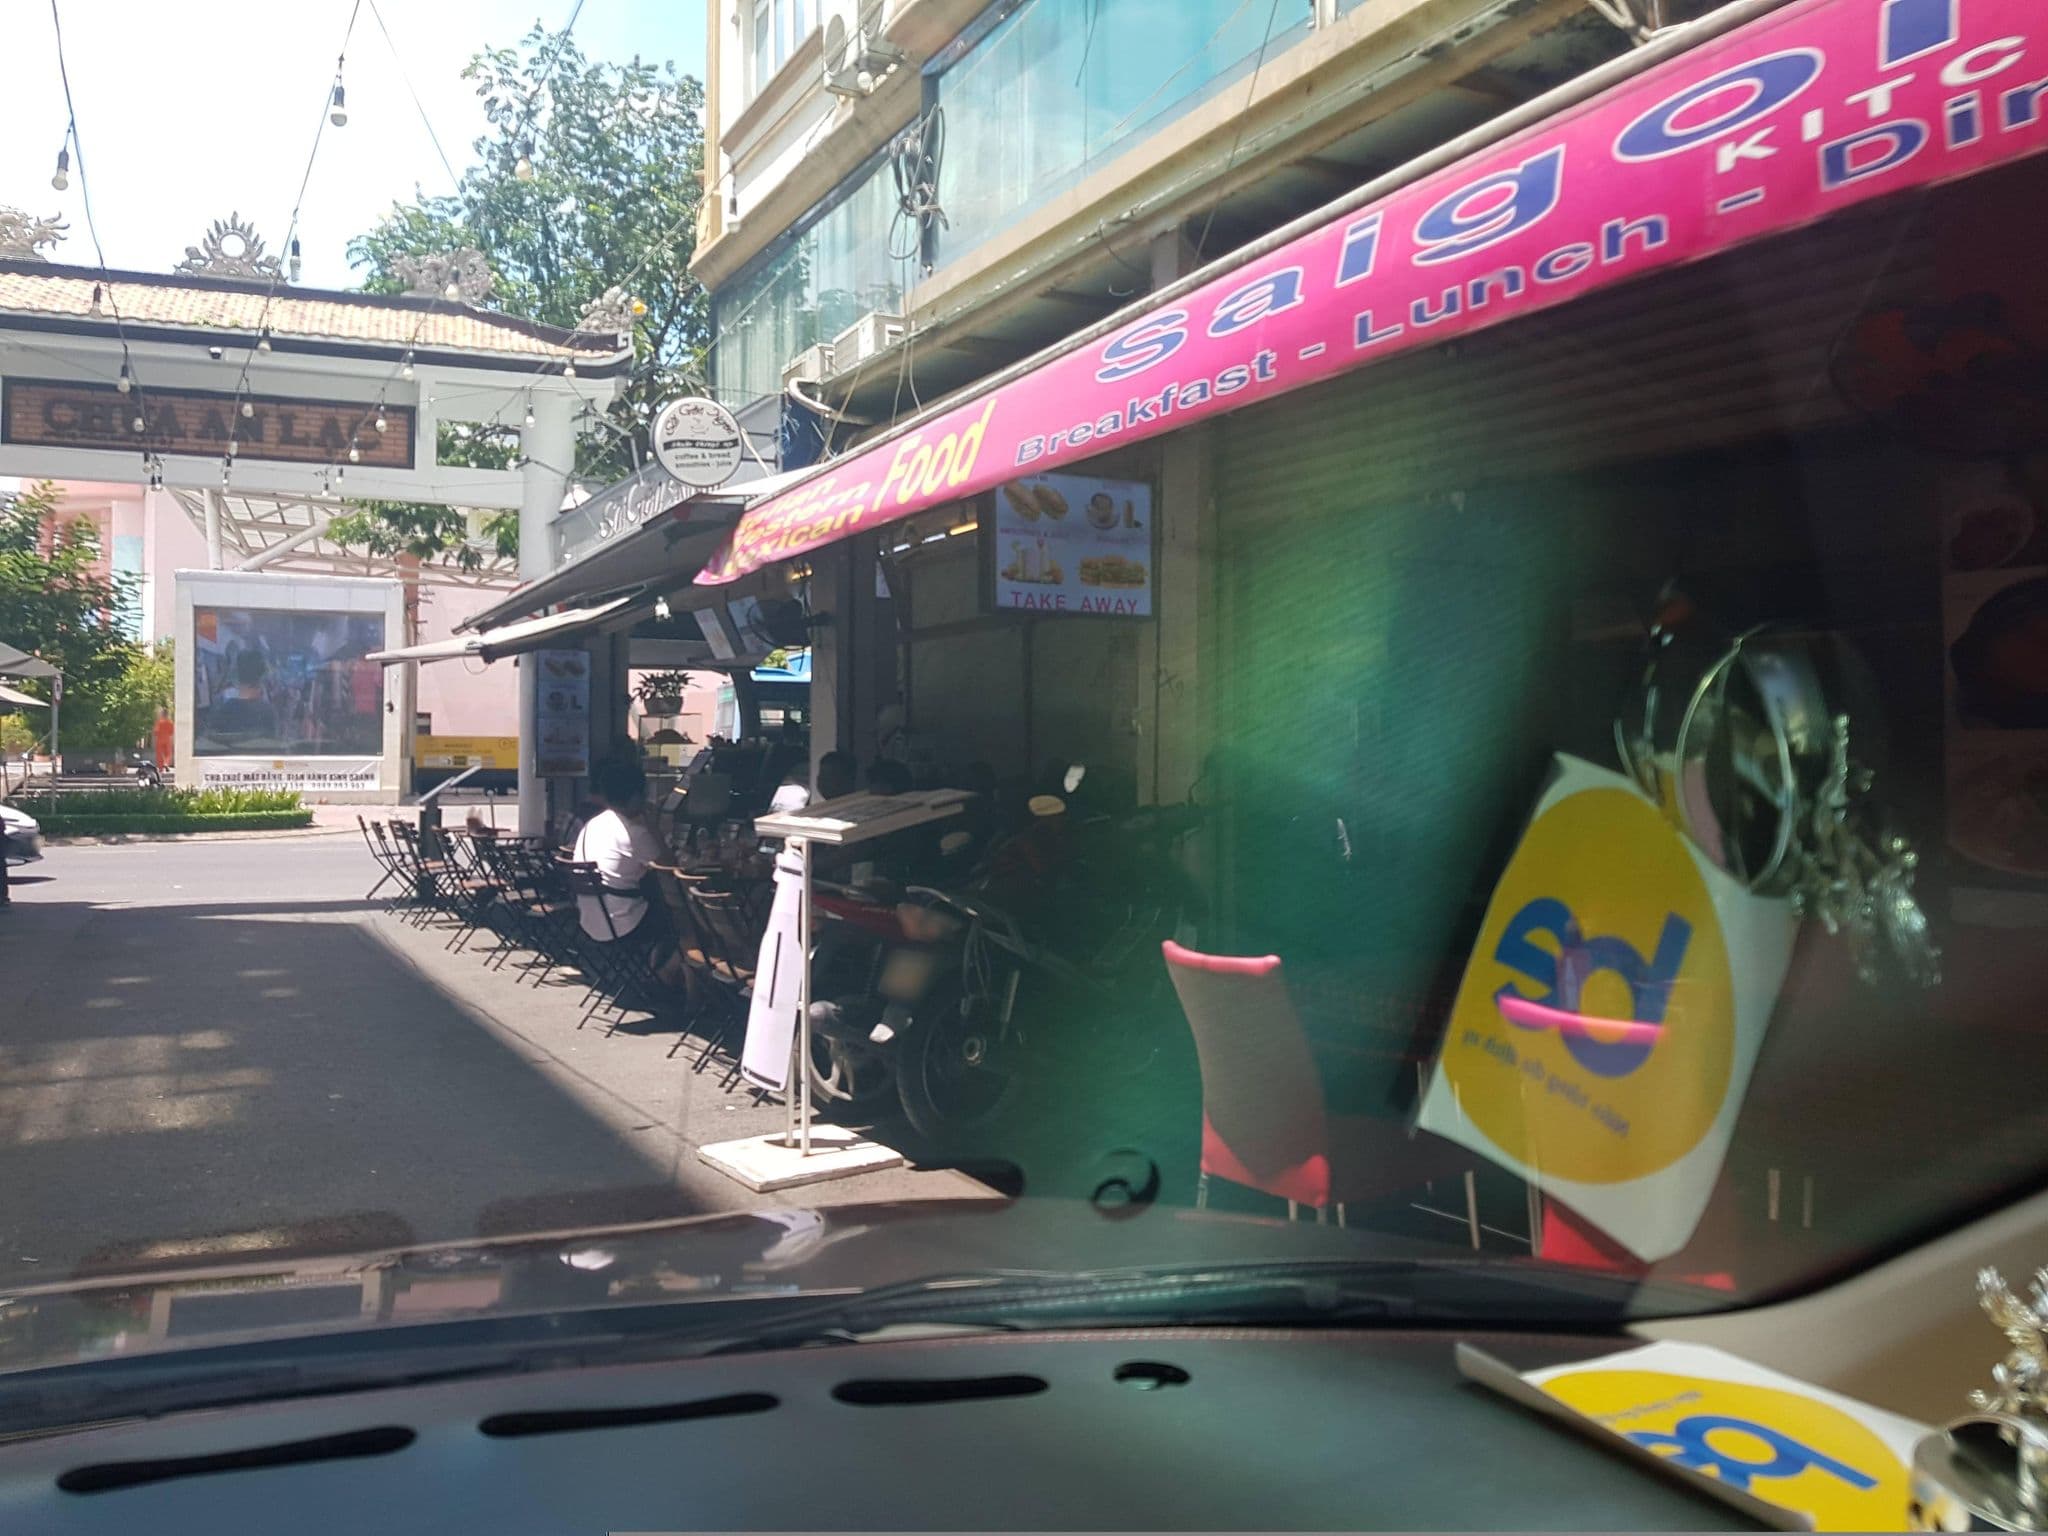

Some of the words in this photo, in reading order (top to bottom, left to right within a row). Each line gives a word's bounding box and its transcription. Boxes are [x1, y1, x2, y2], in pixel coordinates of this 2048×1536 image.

[1015, 350, 1277, 466] Breakfast
[1353, 214, 1669, 349] Lunch
[872, 398, 997, 513] Food
[1011, 591, 1067, 611] TAKE
[1081, 596, 1138, 616] AWAY
